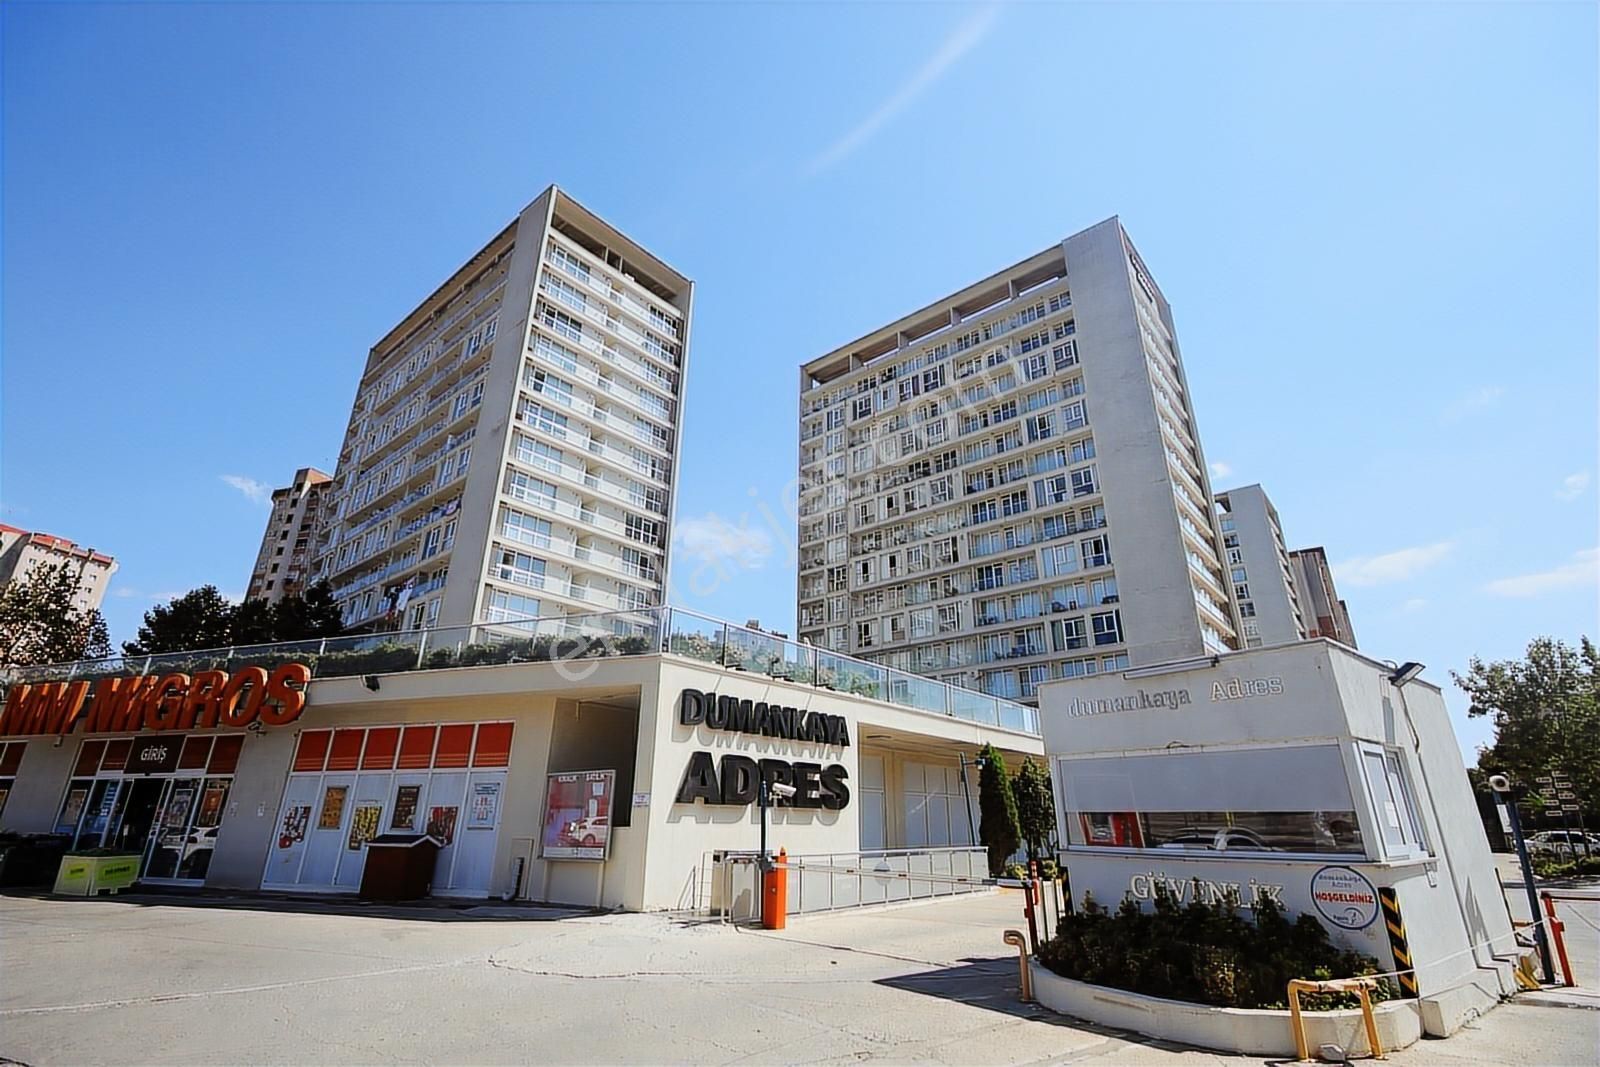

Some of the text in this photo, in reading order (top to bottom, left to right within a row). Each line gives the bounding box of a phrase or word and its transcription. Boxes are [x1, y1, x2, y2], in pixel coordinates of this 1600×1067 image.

[84, 663, 311, 734] MIGROS
[680, 688, 851, 747] DUMANKAYA
[1067, 676, 1284, 718] dumankaya Adres
[140, 744, 168, 764] GİRİŞ
[676, 750, 850, 810] ADRES
